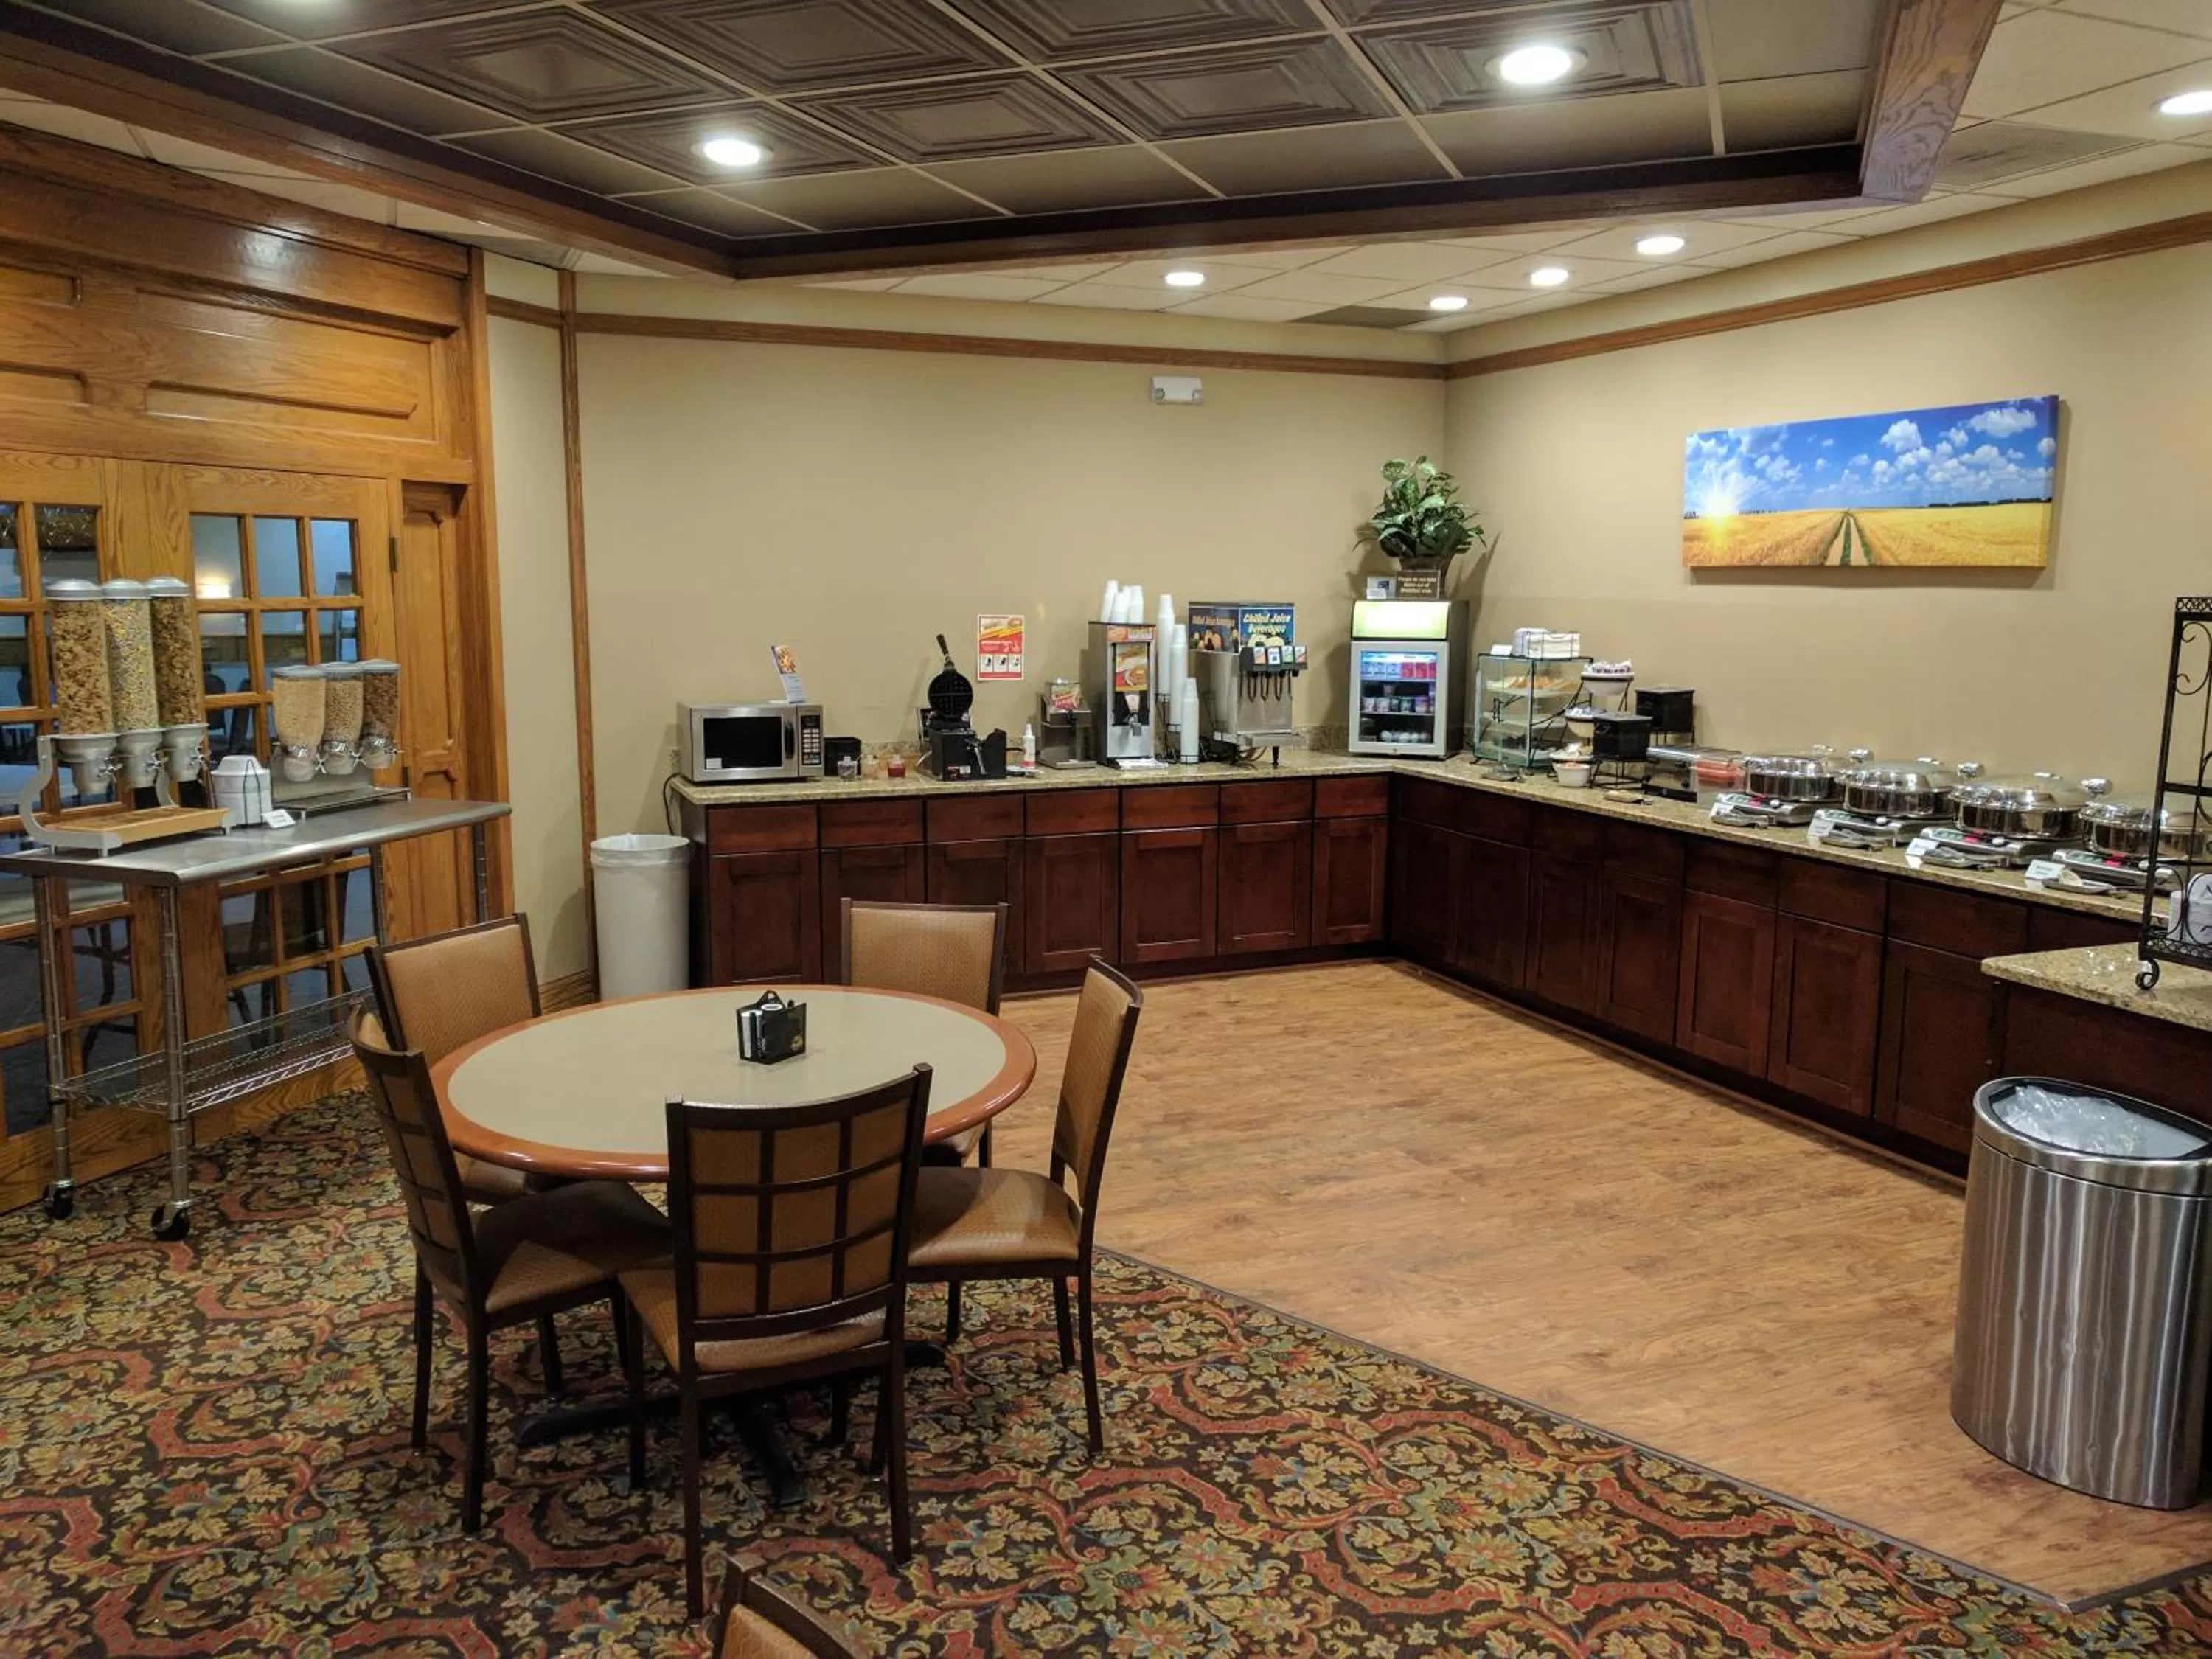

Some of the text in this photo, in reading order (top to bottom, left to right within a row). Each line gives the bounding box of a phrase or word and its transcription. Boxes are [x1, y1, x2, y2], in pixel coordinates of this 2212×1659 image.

[1242, 613, 1291, 623] Chilled Juice
[1248, 624, 1287, 635] Beverages
